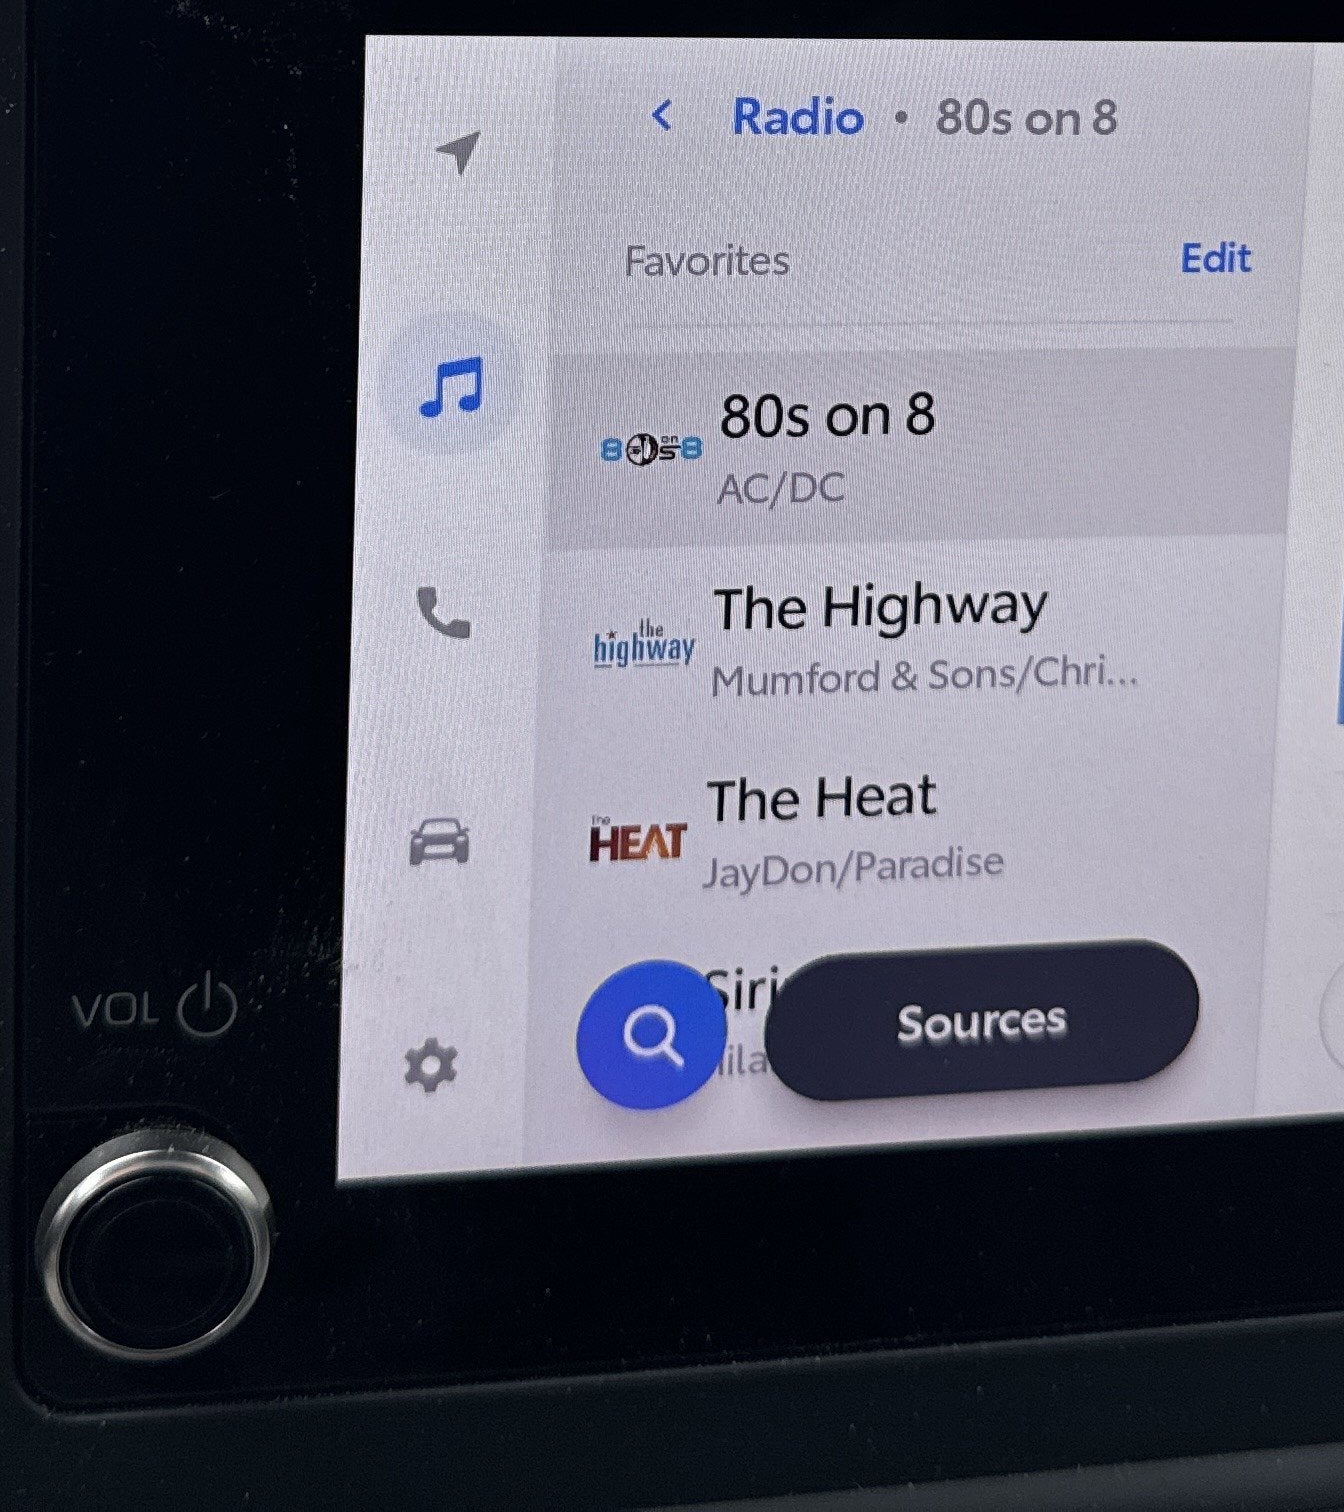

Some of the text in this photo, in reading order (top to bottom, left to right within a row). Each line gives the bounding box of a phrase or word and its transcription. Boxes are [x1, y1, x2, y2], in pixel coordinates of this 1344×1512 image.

[733, 96, 865, 136] Radio
[936, 97, 1118, 136] 80s on 8
[625, 242, 790, 277] Favorites
[1181, 241, 1252, 274] Edit
[720, 391, 936, 439] 80s on 8
[716, 471, 845, 511] AC/DC
[713, 581, 1048, 640] The Highway
[595, 632, 694, 667] highway
[711, 660, 881, 698] Mumford
[890, 660, 918, 692] &
[707, 775, 936, 823] The Heat
[590, 822, 687, 861] HEAT
[702, 845, 1005, 898] JayDon/Paradise
[71, 990, 160, 1028] VOL
[898, 1005, 1067, 1043] Sources
